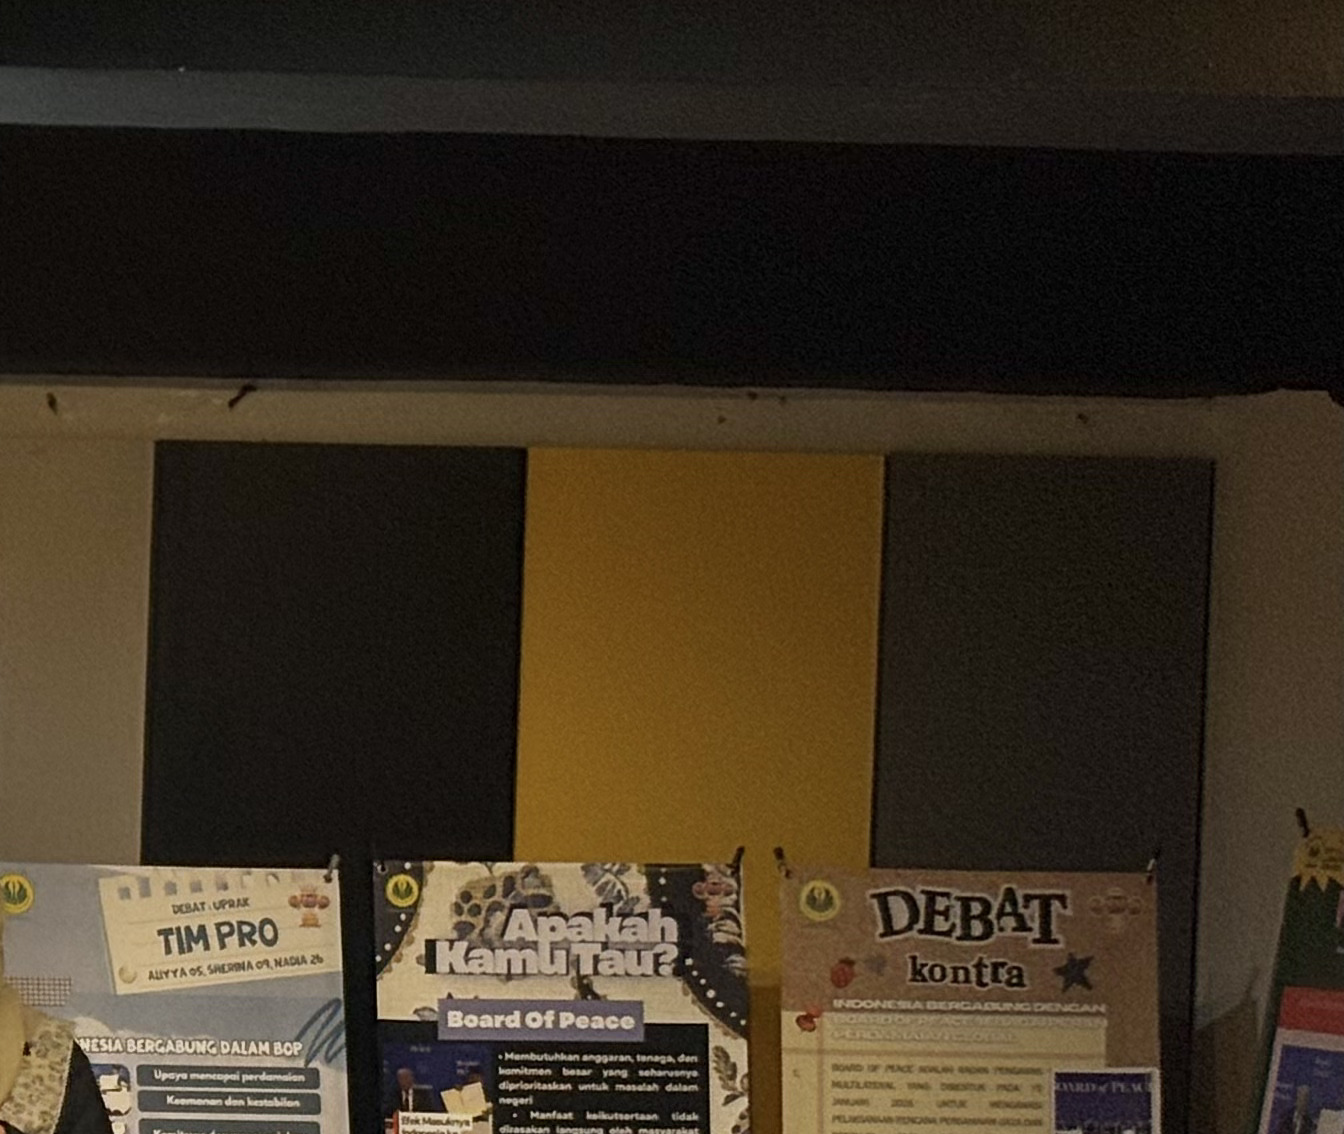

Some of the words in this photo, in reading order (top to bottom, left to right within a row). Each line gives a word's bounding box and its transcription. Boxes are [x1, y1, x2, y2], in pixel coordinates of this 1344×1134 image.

[172, 901, 206, 915] DEBAT
[213, 898, 250, 911] UPRAK
[870, 881, 1072, 948] DEBAT
[503, 908, 678, 942] Apakah
[157, 924, 211, 956] TIM
[215, 918, 279, 950] PRO
[275, 957, 307, 968] NADIA
[310, 954, 324, 964] 26
[435, 941, 569, 975] Kamu
[570, 943, 679, 977] Tau?
[908, 952, 1026, 988] kontra
[833, 999, 924, 1010] INDONESIA
[926, 1001, 1031, 1012] BERGABUNG
[1033, 1003, 1106, 1012] DENGAN
[447, 1010, 521, 1029] Board
[525, 1011, 554, 1029] Of
[560, 1013, 636, 1030] Peace
[125, 1039, 217, 1055] BERGABUNG
[221, 1041, 270, 1056] DALAM
[274, 1042, 302, 1056] BOP
[504, 1052, 580, 1063] Membutuhkan
[154, 1069, 188, 1082] Upaya
[190, 1071, 240, 1082] mencapai
[242, 1073, 305, 1083] perdamaian
[499, 1081, 572, 1093] diprioritaskan
[167, 1096, 223, 1106] Keamanan
[225, 1096, 245, 1107] dan
[247, 1097, 301, 1107] kestabilan
[530, 1111, 574, 1120] Manfaat
